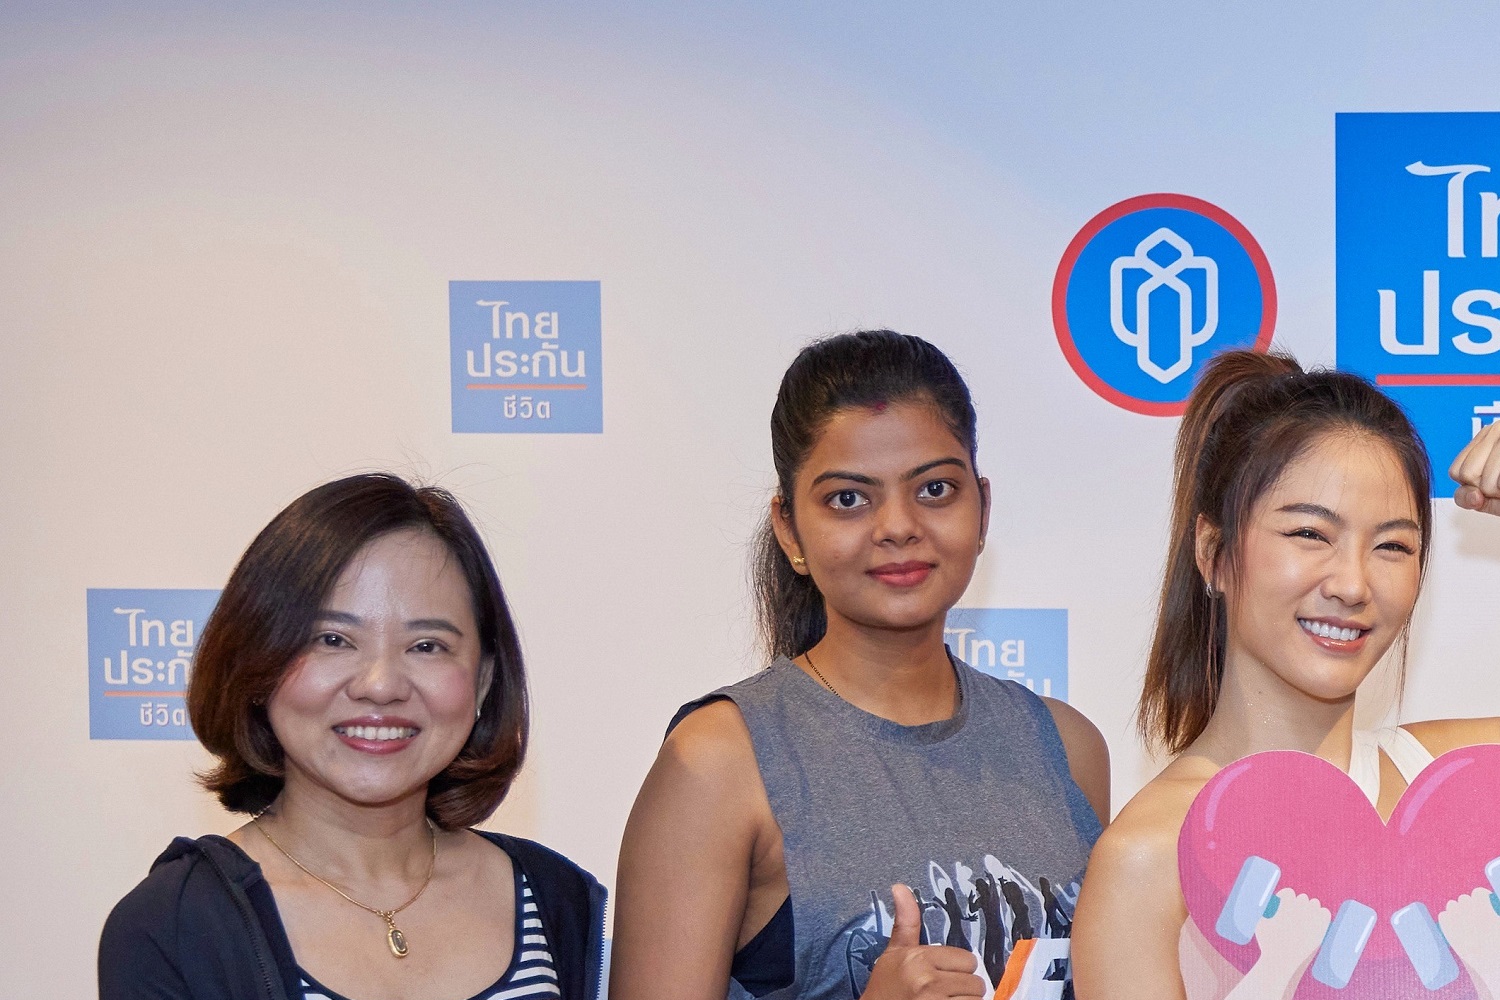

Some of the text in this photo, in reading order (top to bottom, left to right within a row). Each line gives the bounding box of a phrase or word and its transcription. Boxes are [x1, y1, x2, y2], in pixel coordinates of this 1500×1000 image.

[475, 299, 559, 339] ไทย
[465, 342, 587, 378] ประกัน
[503, 394, 552, 419] ชีวิต
[113, 607, 194, 647] ไทย
[944, 627, 1025, 667] ไทย
[103, 650, 194, 685] ประกั
[140, 702, 187, 726] ชีวิต
